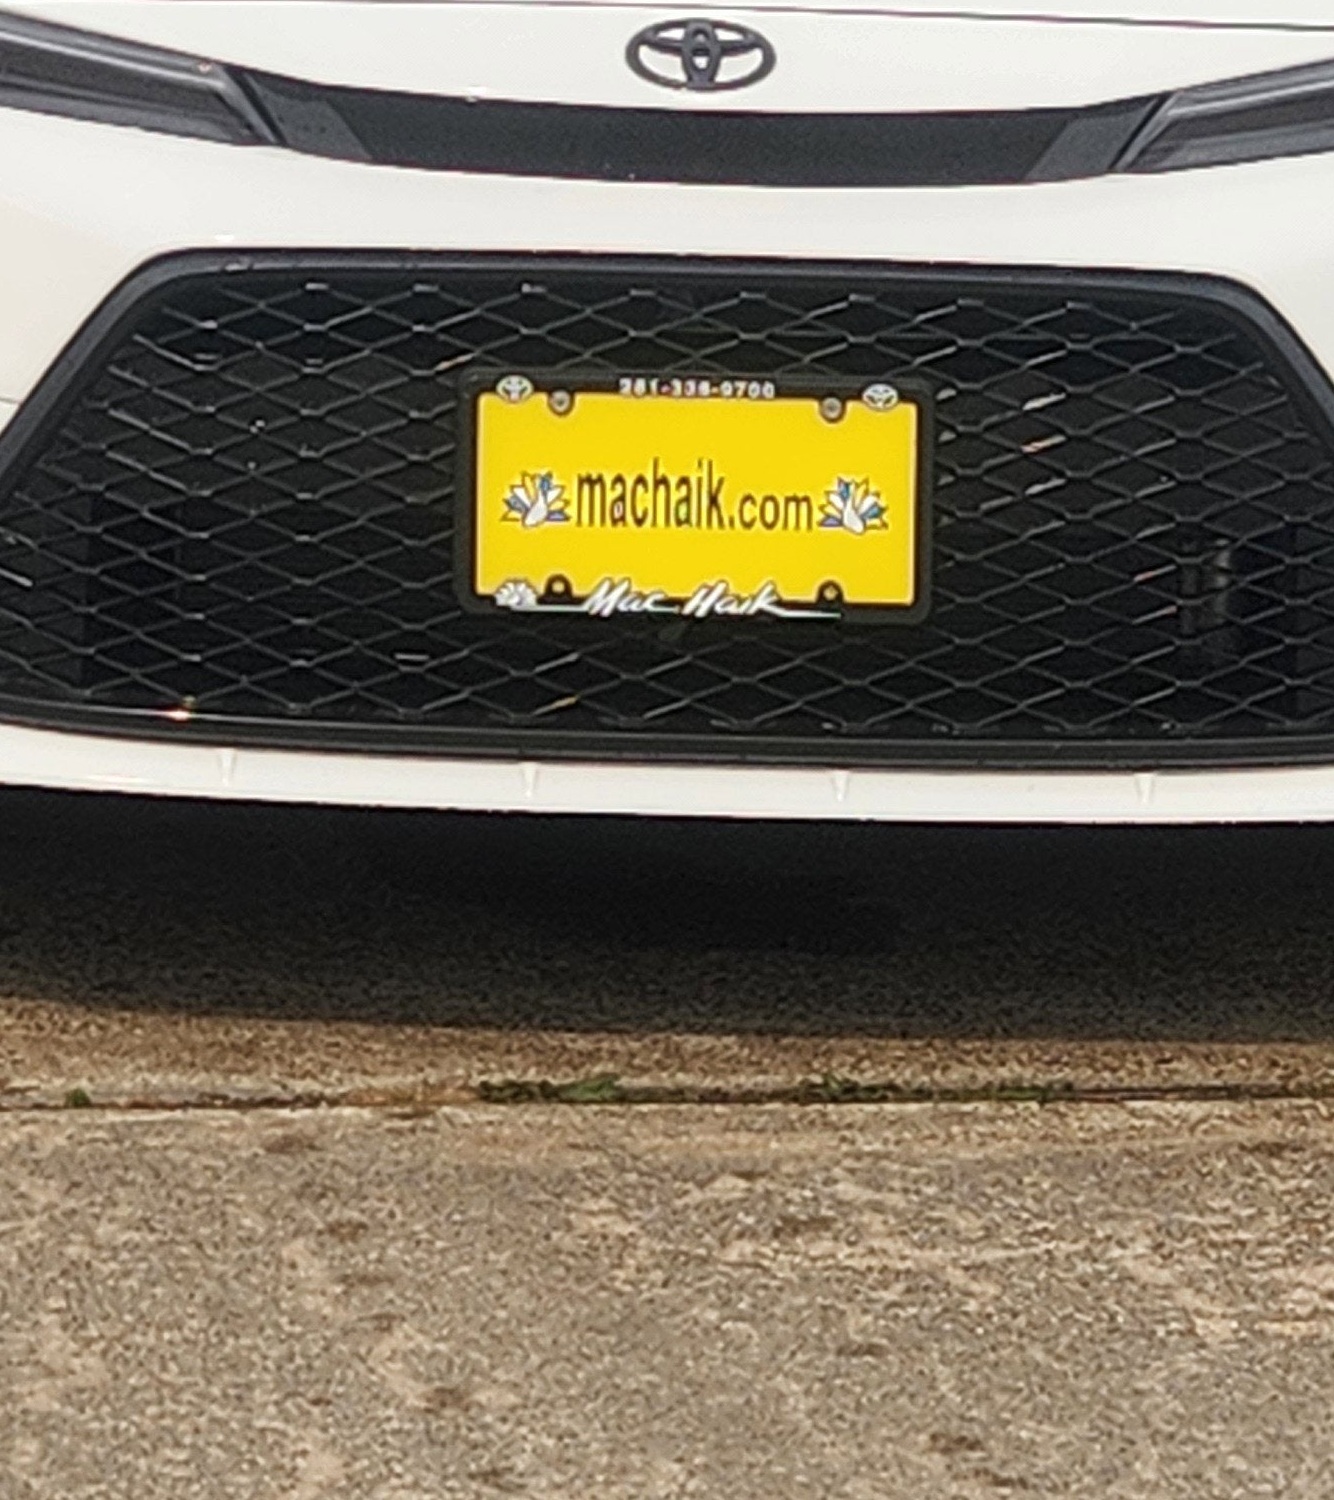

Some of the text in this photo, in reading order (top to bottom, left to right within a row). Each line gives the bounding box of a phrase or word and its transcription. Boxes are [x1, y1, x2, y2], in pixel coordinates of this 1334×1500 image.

[576, 457, 813, 531] machaik.com
[586, 578, 779, 617] Mac Haik
